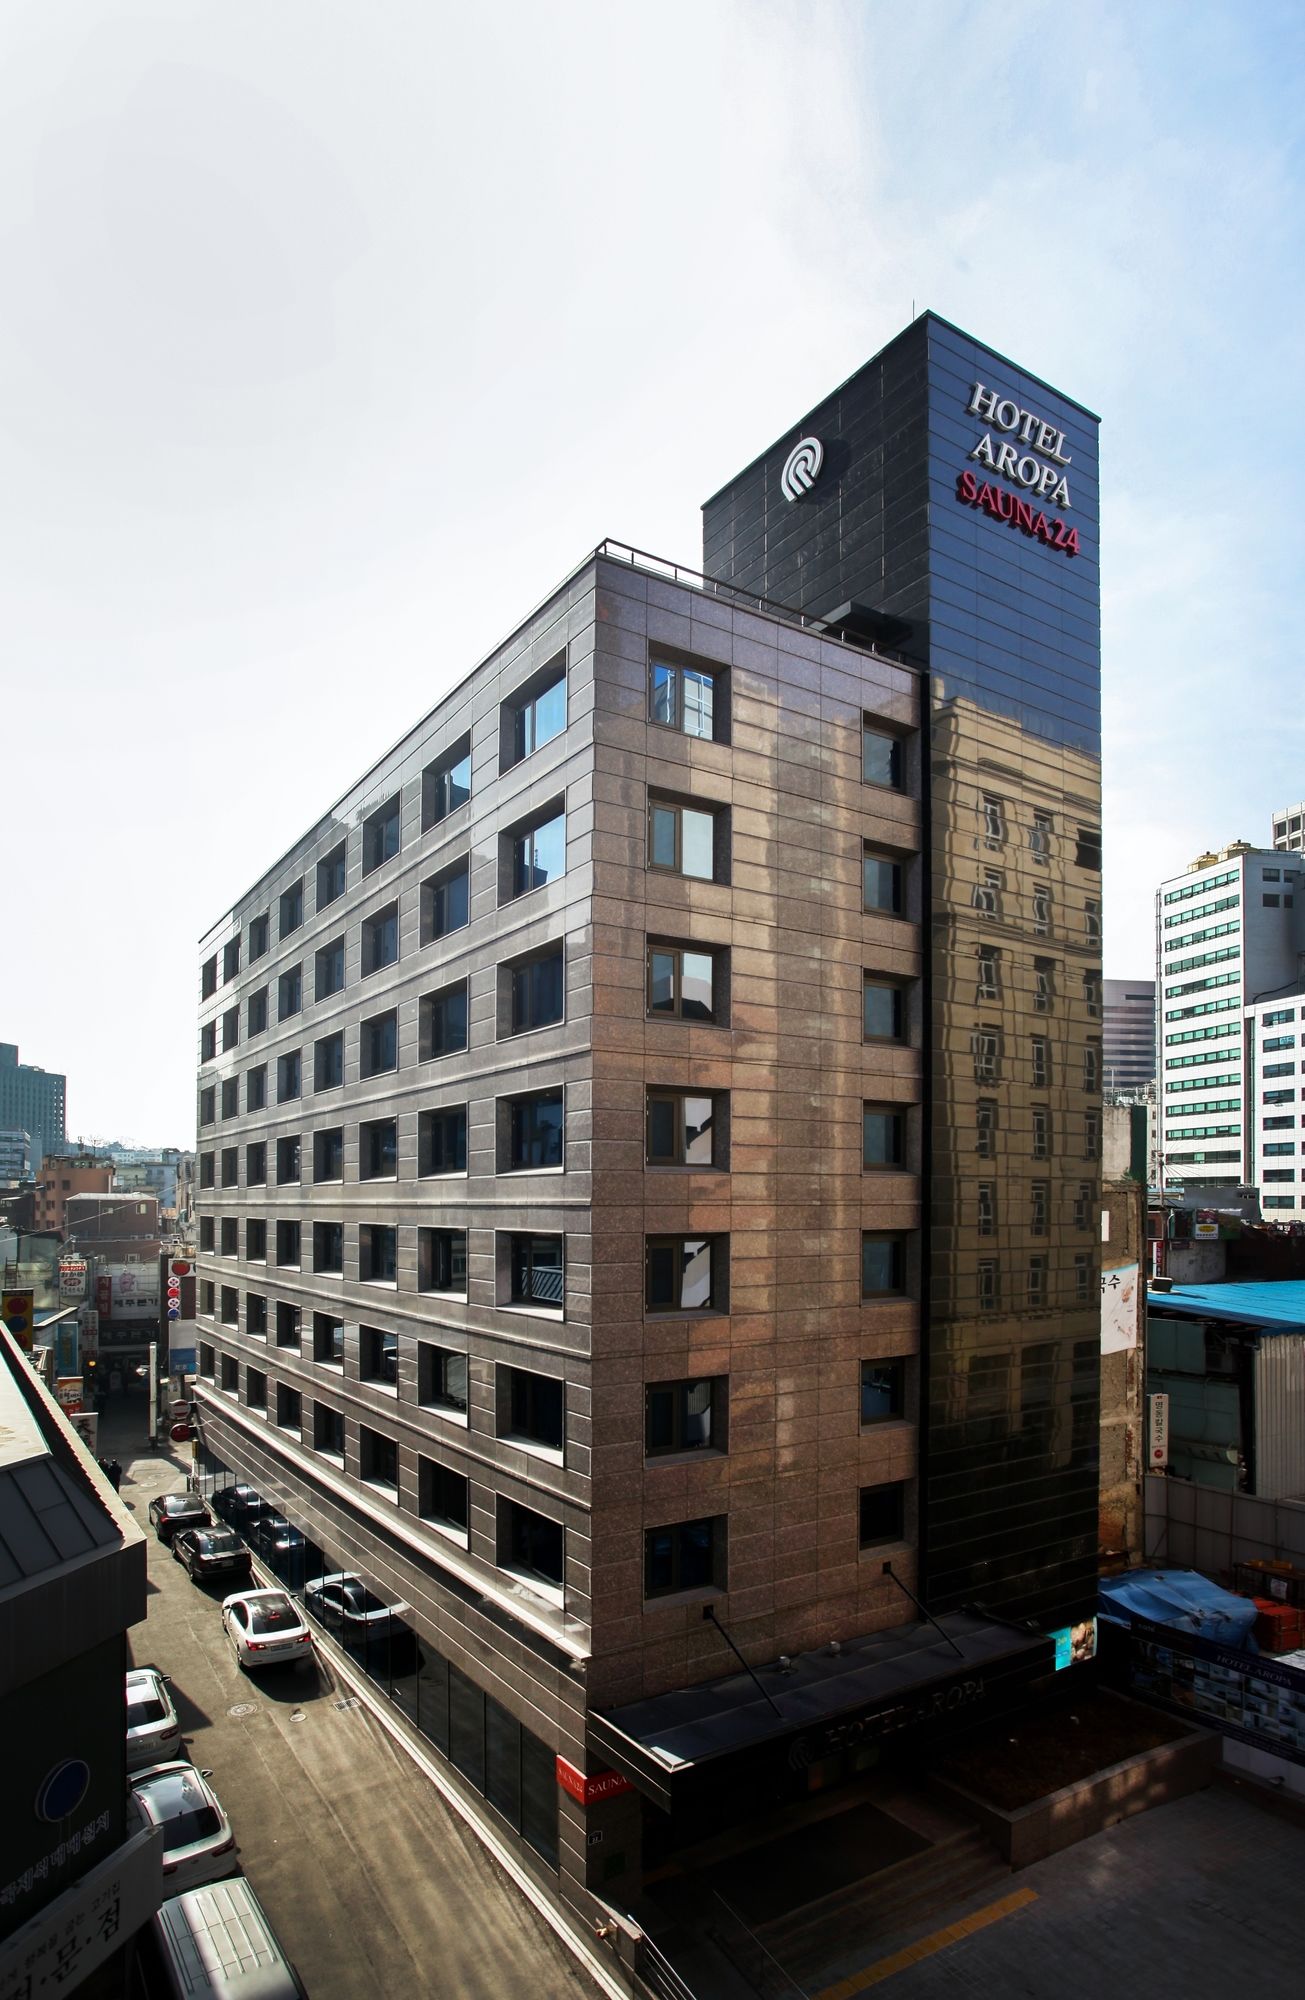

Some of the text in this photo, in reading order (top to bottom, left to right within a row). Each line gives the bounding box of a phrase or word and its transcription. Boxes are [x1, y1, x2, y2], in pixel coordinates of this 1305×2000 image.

[968, 381, 1072, 465] HOTEL
[959, 469, 1081, 555] SAUNA24
[970, 433, 1072, 509] AROPA
